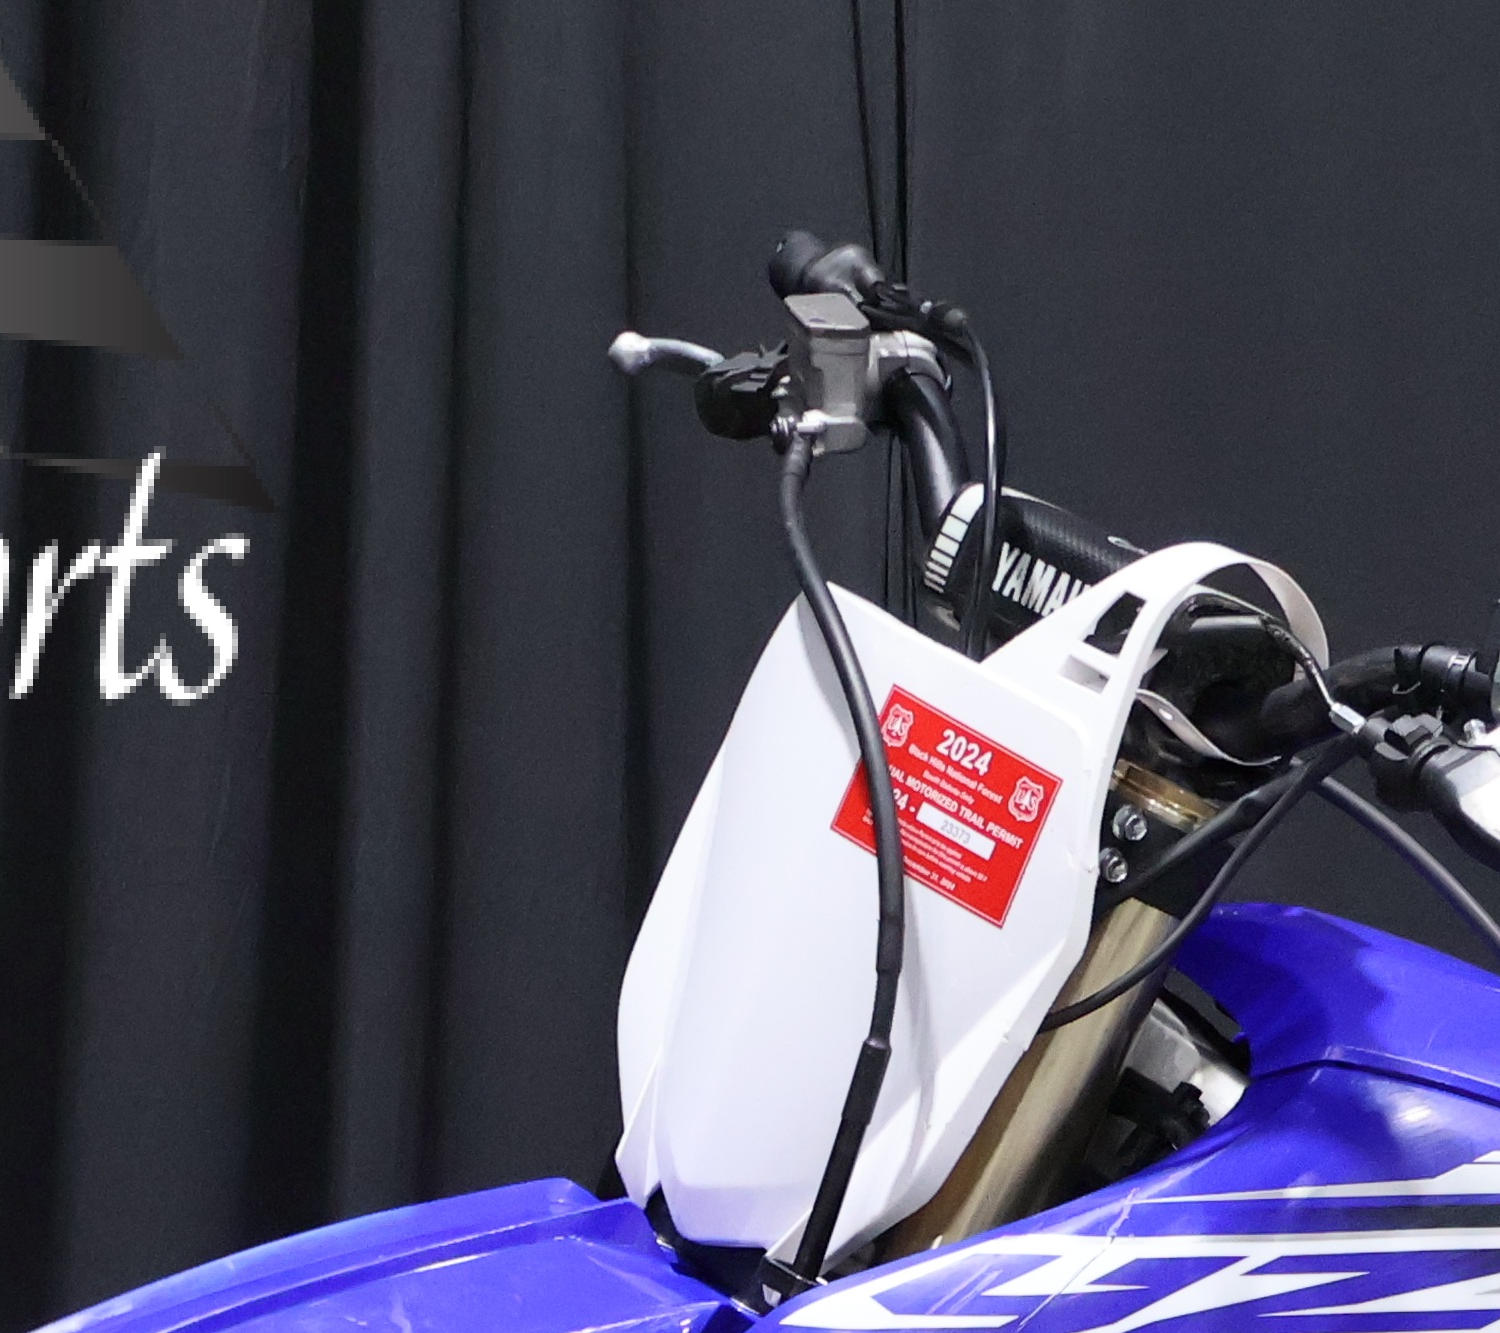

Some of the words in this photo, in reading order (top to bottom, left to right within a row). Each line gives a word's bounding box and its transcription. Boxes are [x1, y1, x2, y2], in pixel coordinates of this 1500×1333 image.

[991, 541, 1092, 618] YAMA
[935, 728, 993, 776] 2024
[946, 765, 978, 789] National
[976, 783, 1003, 804] Forest
[905, 775, 958, 812] MOTORIZED
[958, 804, 986, 829] TRAIL
[985, 821, 1023, 849] PERMIT
[940, 820, 971, 844] 23373
